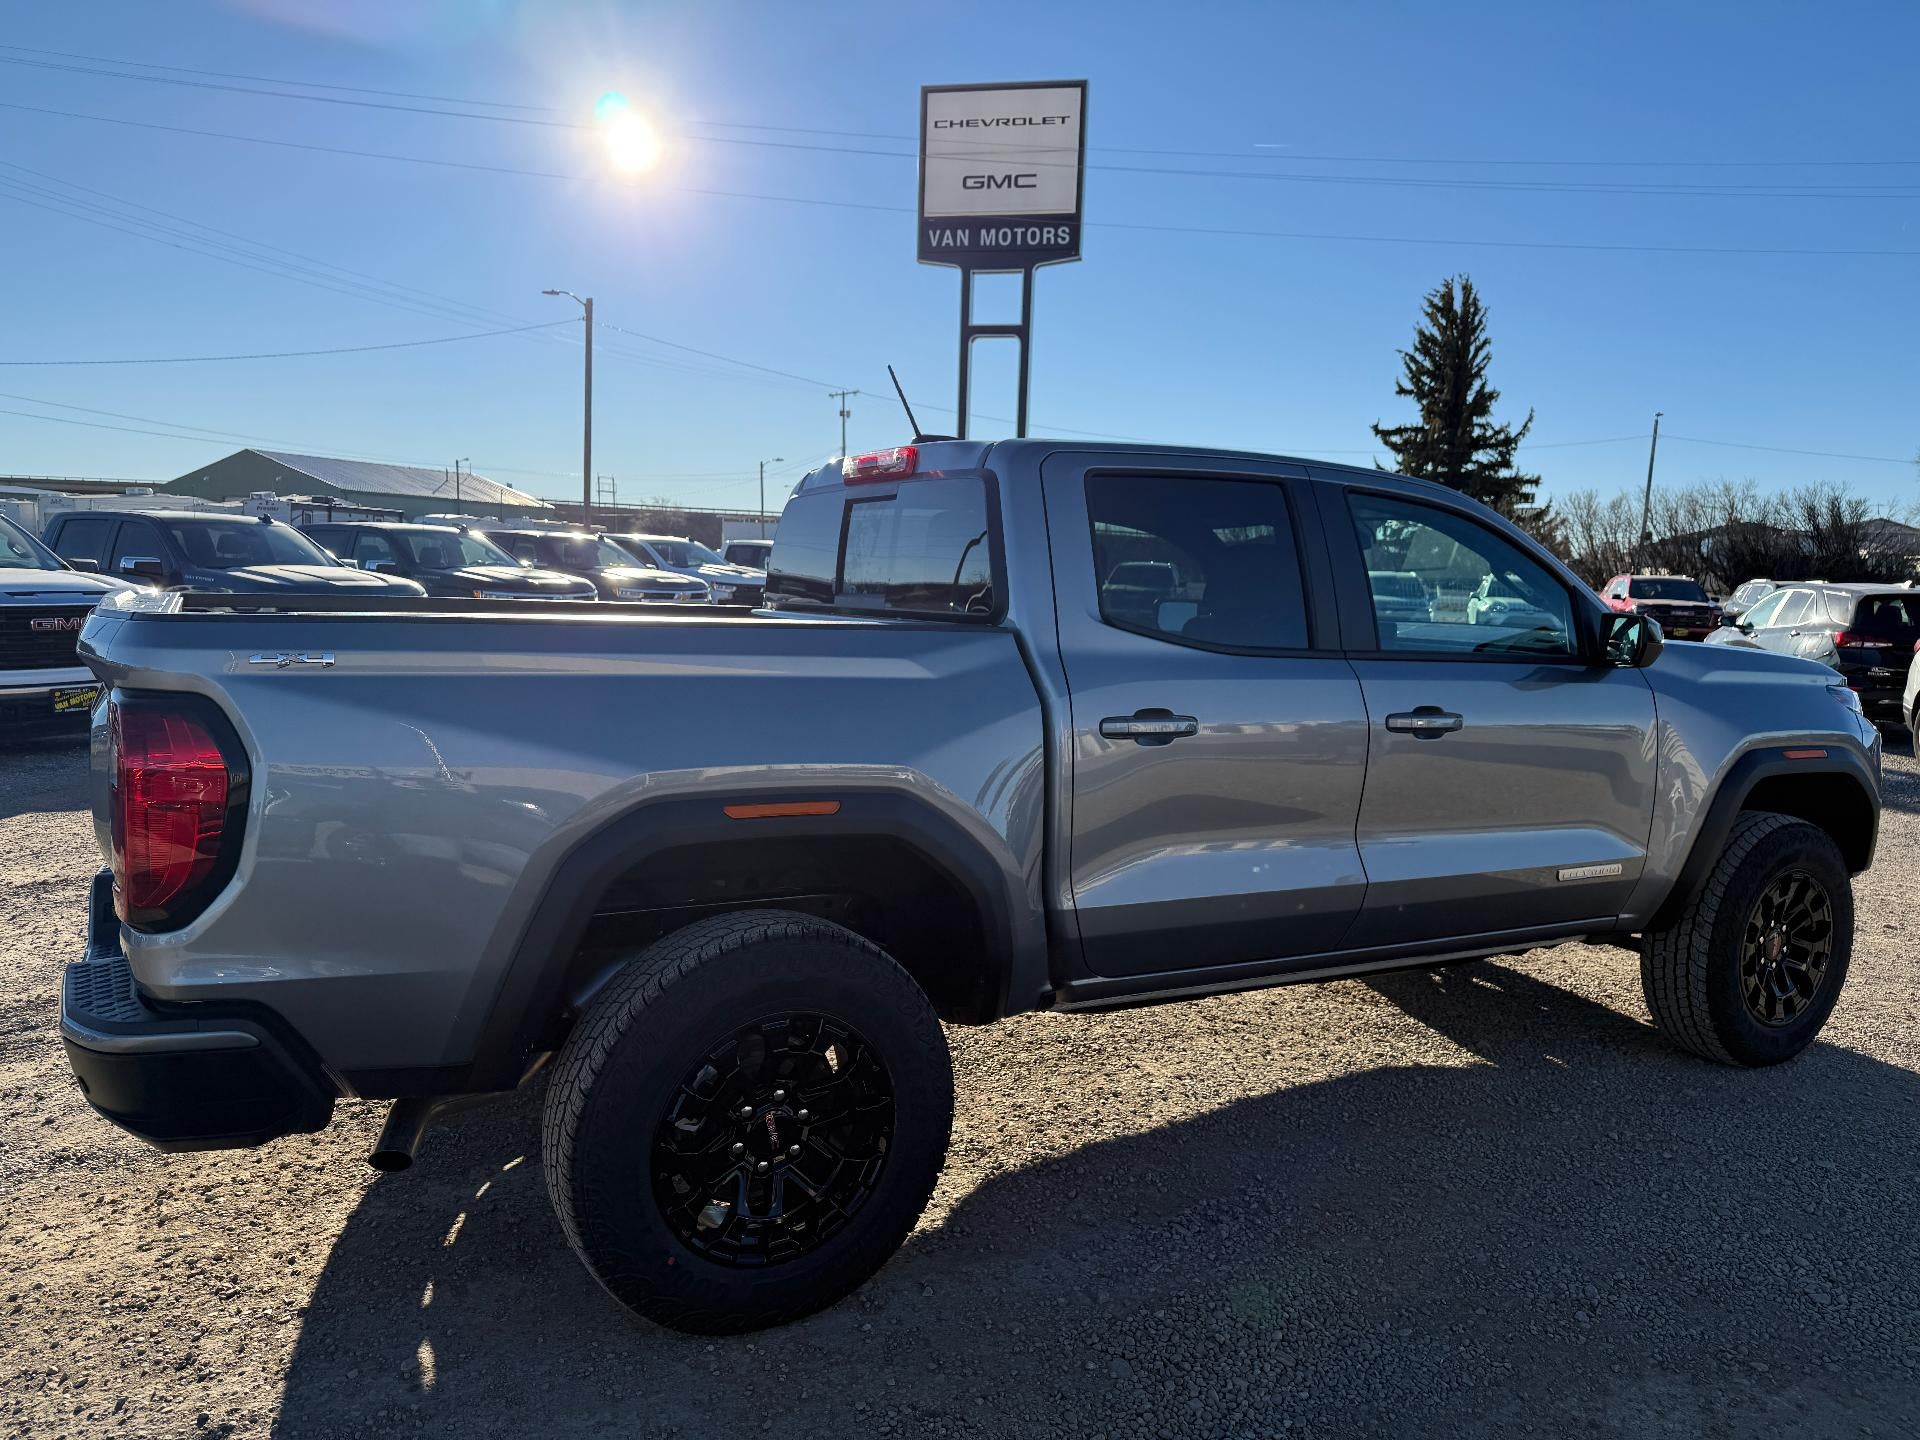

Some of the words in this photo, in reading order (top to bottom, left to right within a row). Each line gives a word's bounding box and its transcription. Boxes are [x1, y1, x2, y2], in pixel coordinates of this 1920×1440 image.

[934, 116, 1070, 129] CHEVROLET
[962, 174, 1037, 189] GMC
[928, 230, 969, 247] VAN
[980, 226, 1070, 246] MOTORS
[31, 618, 84, 630] GM
